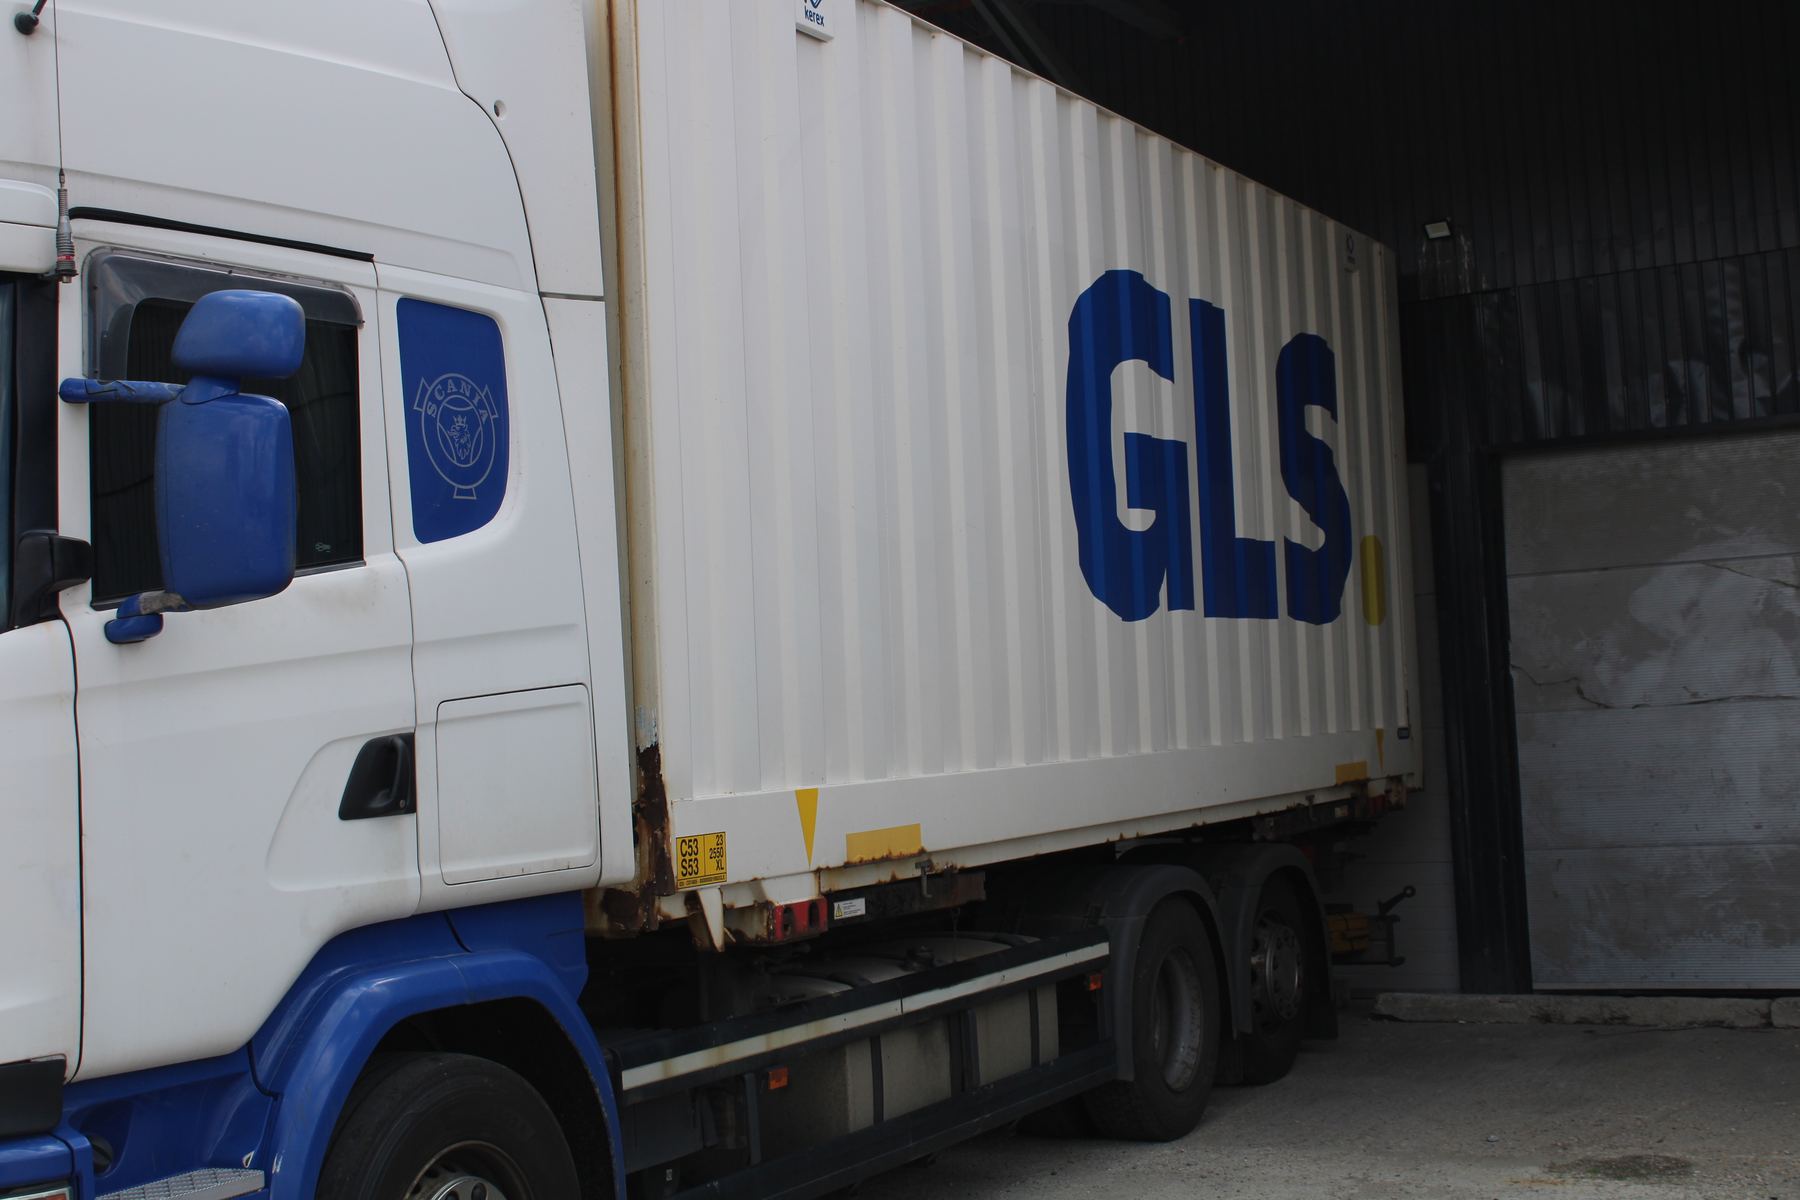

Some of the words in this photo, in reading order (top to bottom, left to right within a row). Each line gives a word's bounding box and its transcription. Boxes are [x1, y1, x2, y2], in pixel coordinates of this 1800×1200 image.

[804, 5, 825, 27] kerex
[426, 378, 490, 425] SCANIA
[680, 838, 699, 857] C53
[715, 834, 724, 846] 23
[709, 846, 724, 859] 2550
[680, 857, 699, 877] S53
[715, 858, 724, 871] XL
